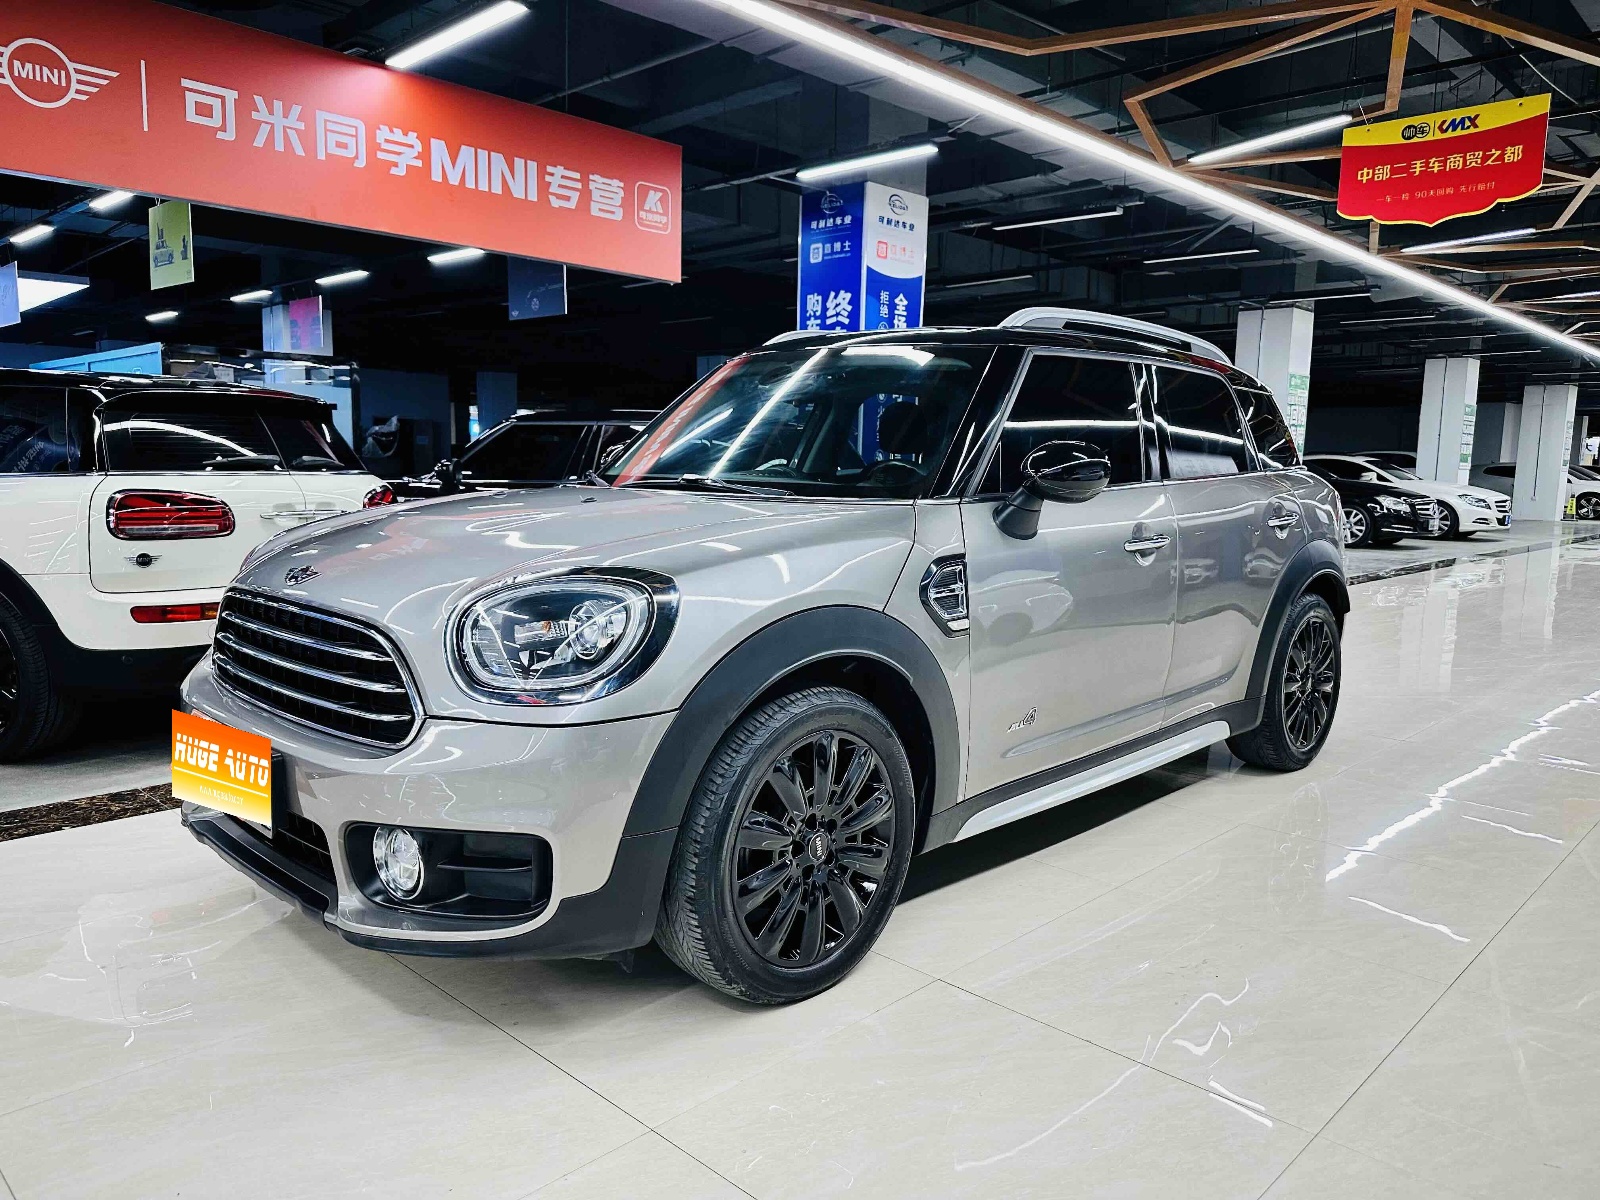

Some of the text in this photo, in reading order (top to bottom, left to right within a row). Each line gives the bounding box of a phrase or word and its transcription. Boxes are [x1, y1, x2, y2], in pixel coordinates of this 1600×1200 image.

[12, 61, 67, 88] MINI
[180, 77, 624, 222] 可米同学MINI专营
[1357, 144, 1524, 184] 中部二手车商贸之都
[826, 289, 853, 332] 终
